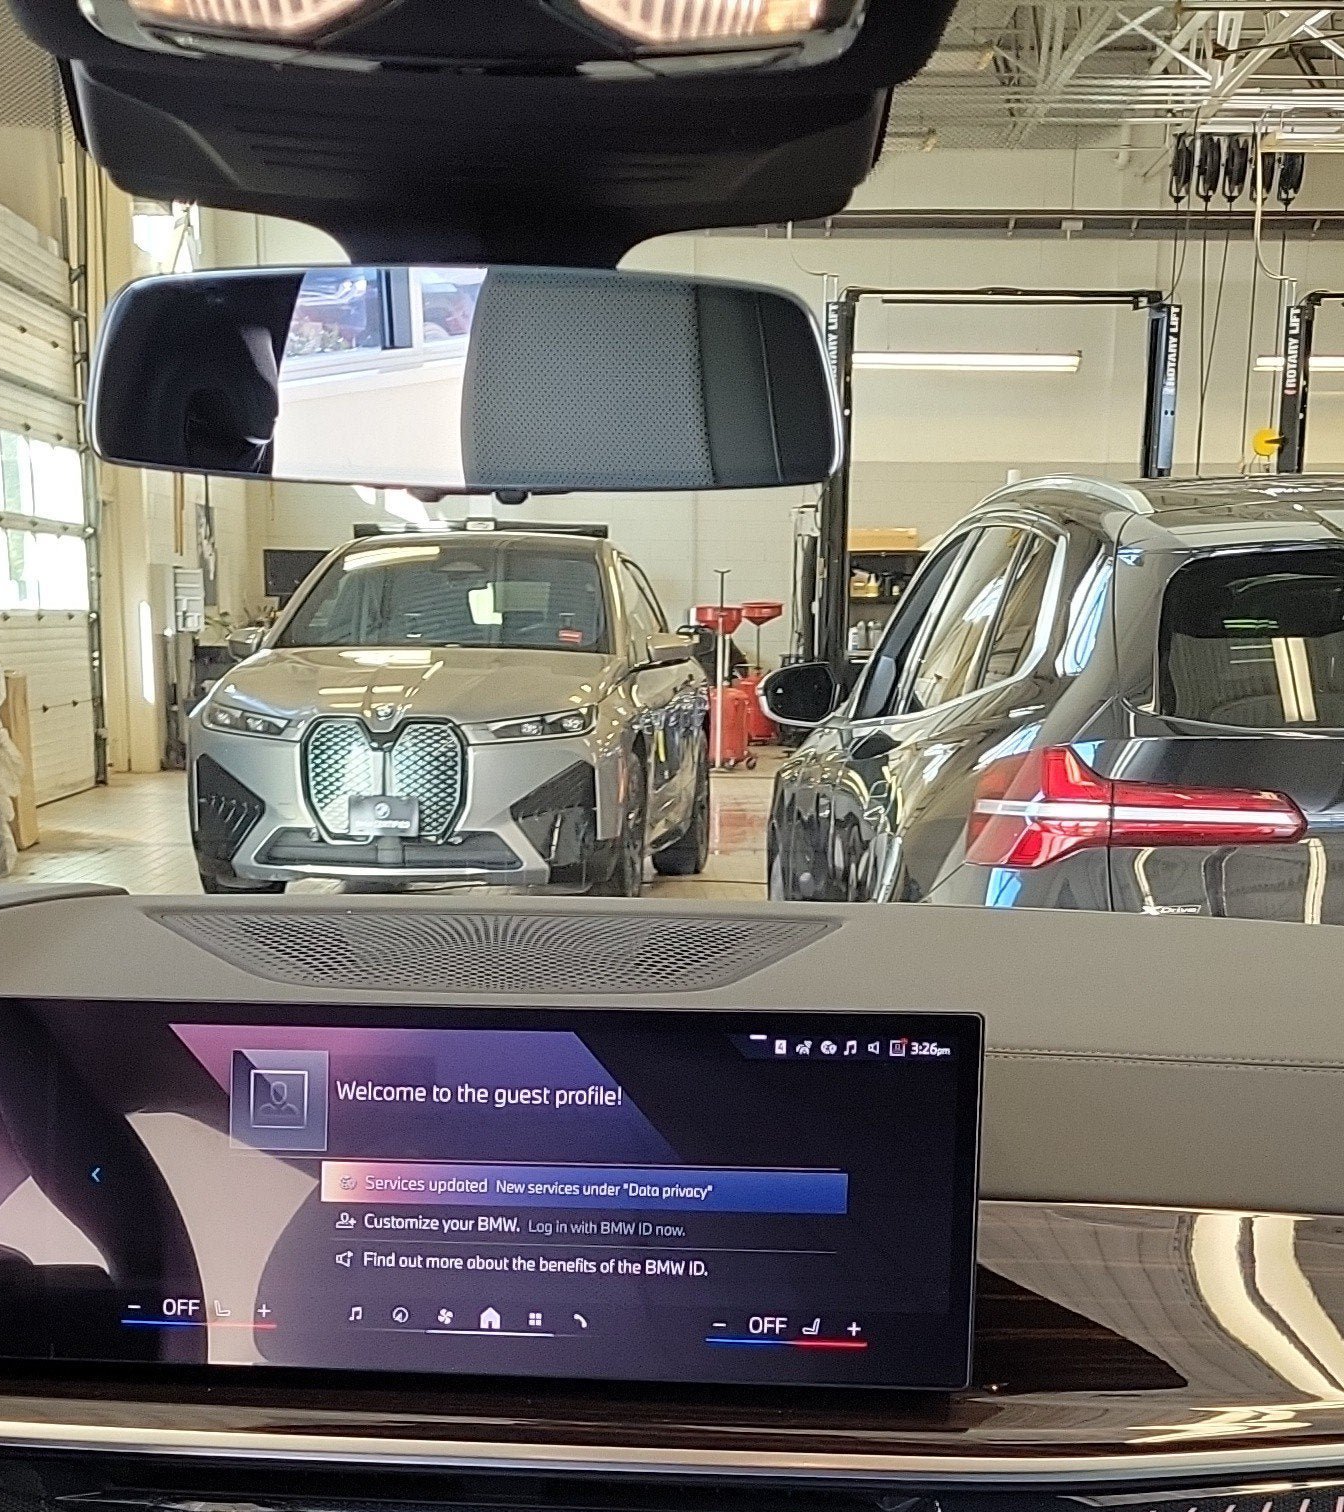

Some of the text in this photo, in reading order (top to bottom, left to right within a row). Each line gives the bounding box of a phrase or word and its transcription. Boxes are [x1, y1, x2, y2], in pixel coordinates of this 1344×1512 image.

[828, 303, 839, 330] LIFT
[1169, 307, 1181, 333] LIFT
[1285, 308, 1301, 388] ROTARY LIFT
[336, 1081, 622, 1108] Welcome to the guest profile!
[365, 1175, 713, 1201] Services updated New services under "Data privacy"
[364, 1214, 686, 1237] Customize your BMW. Log in with BMW ID now.
[363, 1251, 708, 1276] Find out more about the benefits of the BMW ID.
[162, 1298, 200, 1316] OFF
[749, 1316, 788, 1335] OFF
